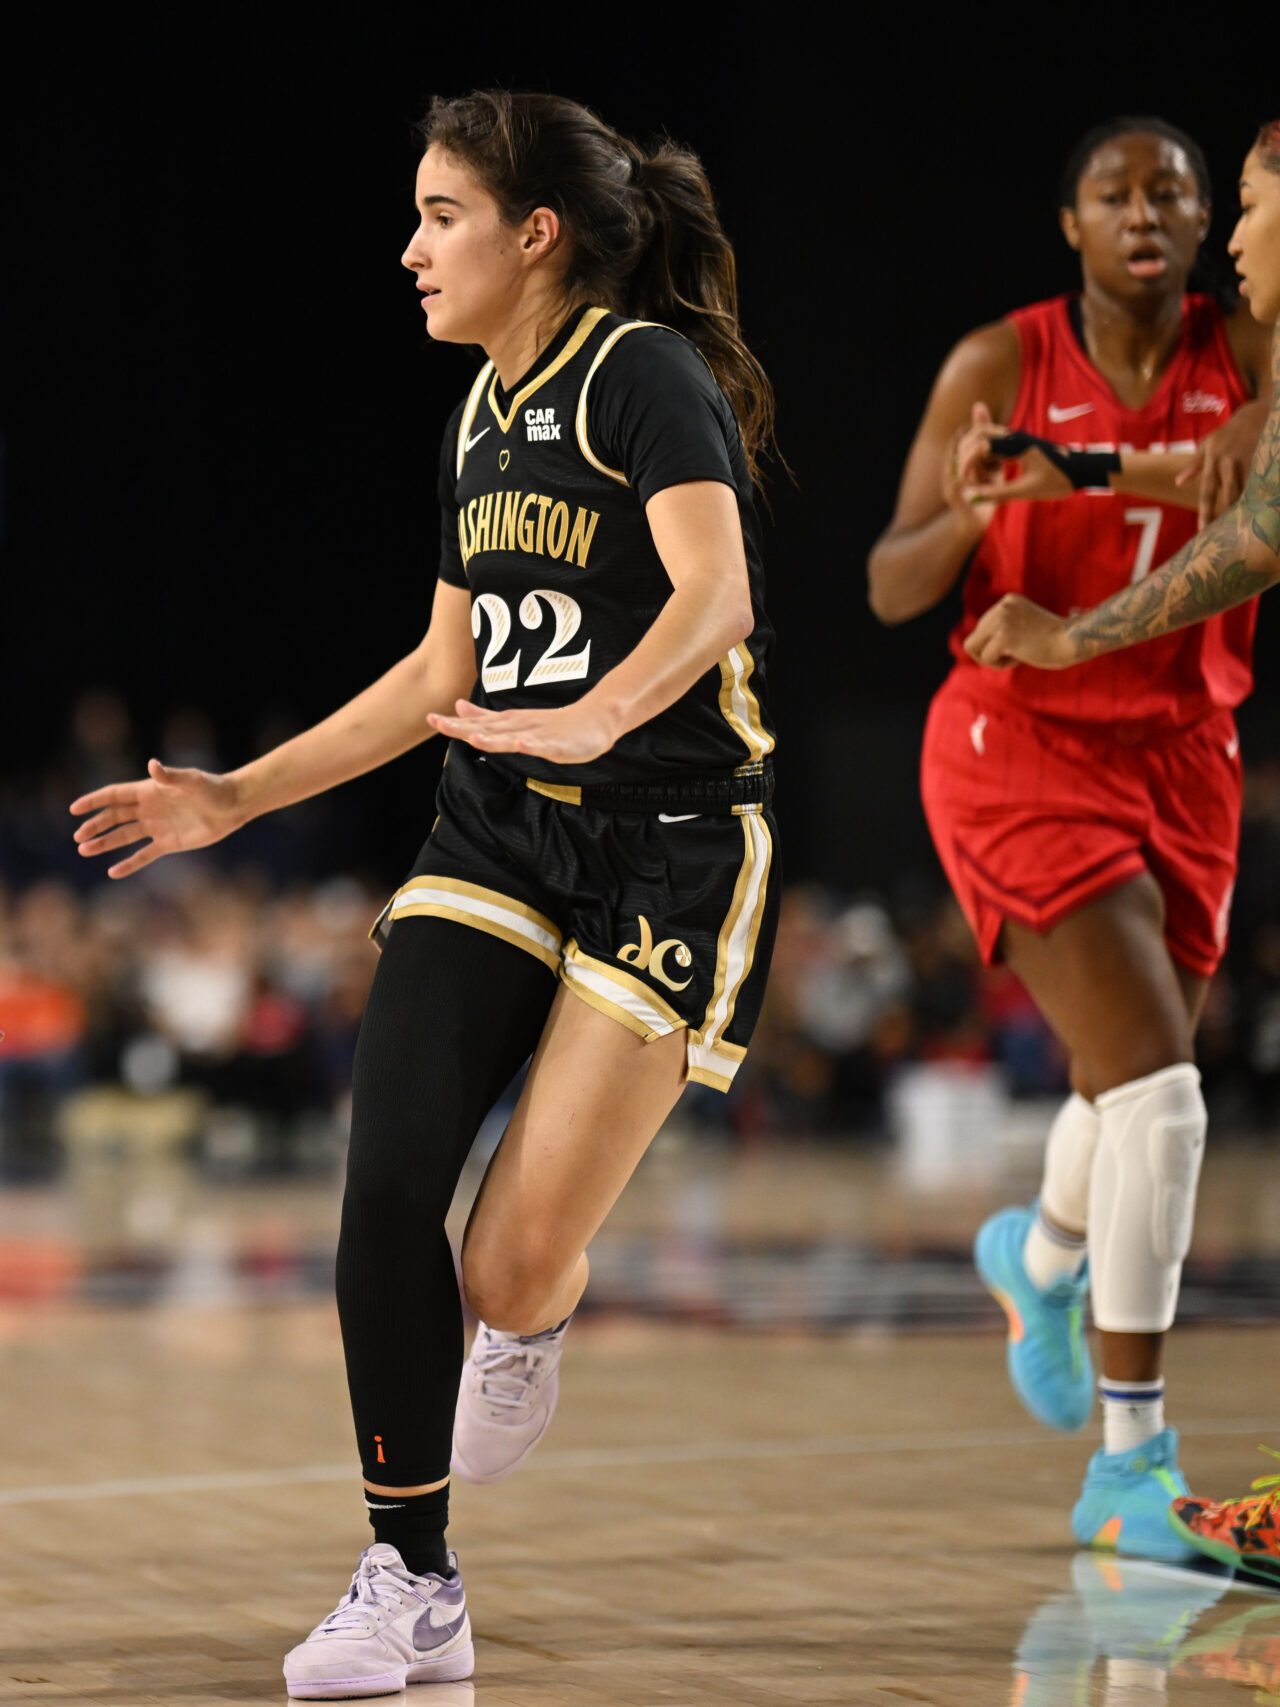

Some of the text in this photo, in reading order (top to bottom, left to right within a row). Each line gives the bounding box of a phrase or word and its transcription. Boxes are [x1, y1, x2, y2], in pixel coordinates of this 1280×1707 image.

[524, 408, 556, 425] CAR
[526, 424, 562, 442] max
[458, 491, 601, 572] ASHINGTON
[1124, 507, 1163, 585] 7
[471, 589, 591, 693] 22
